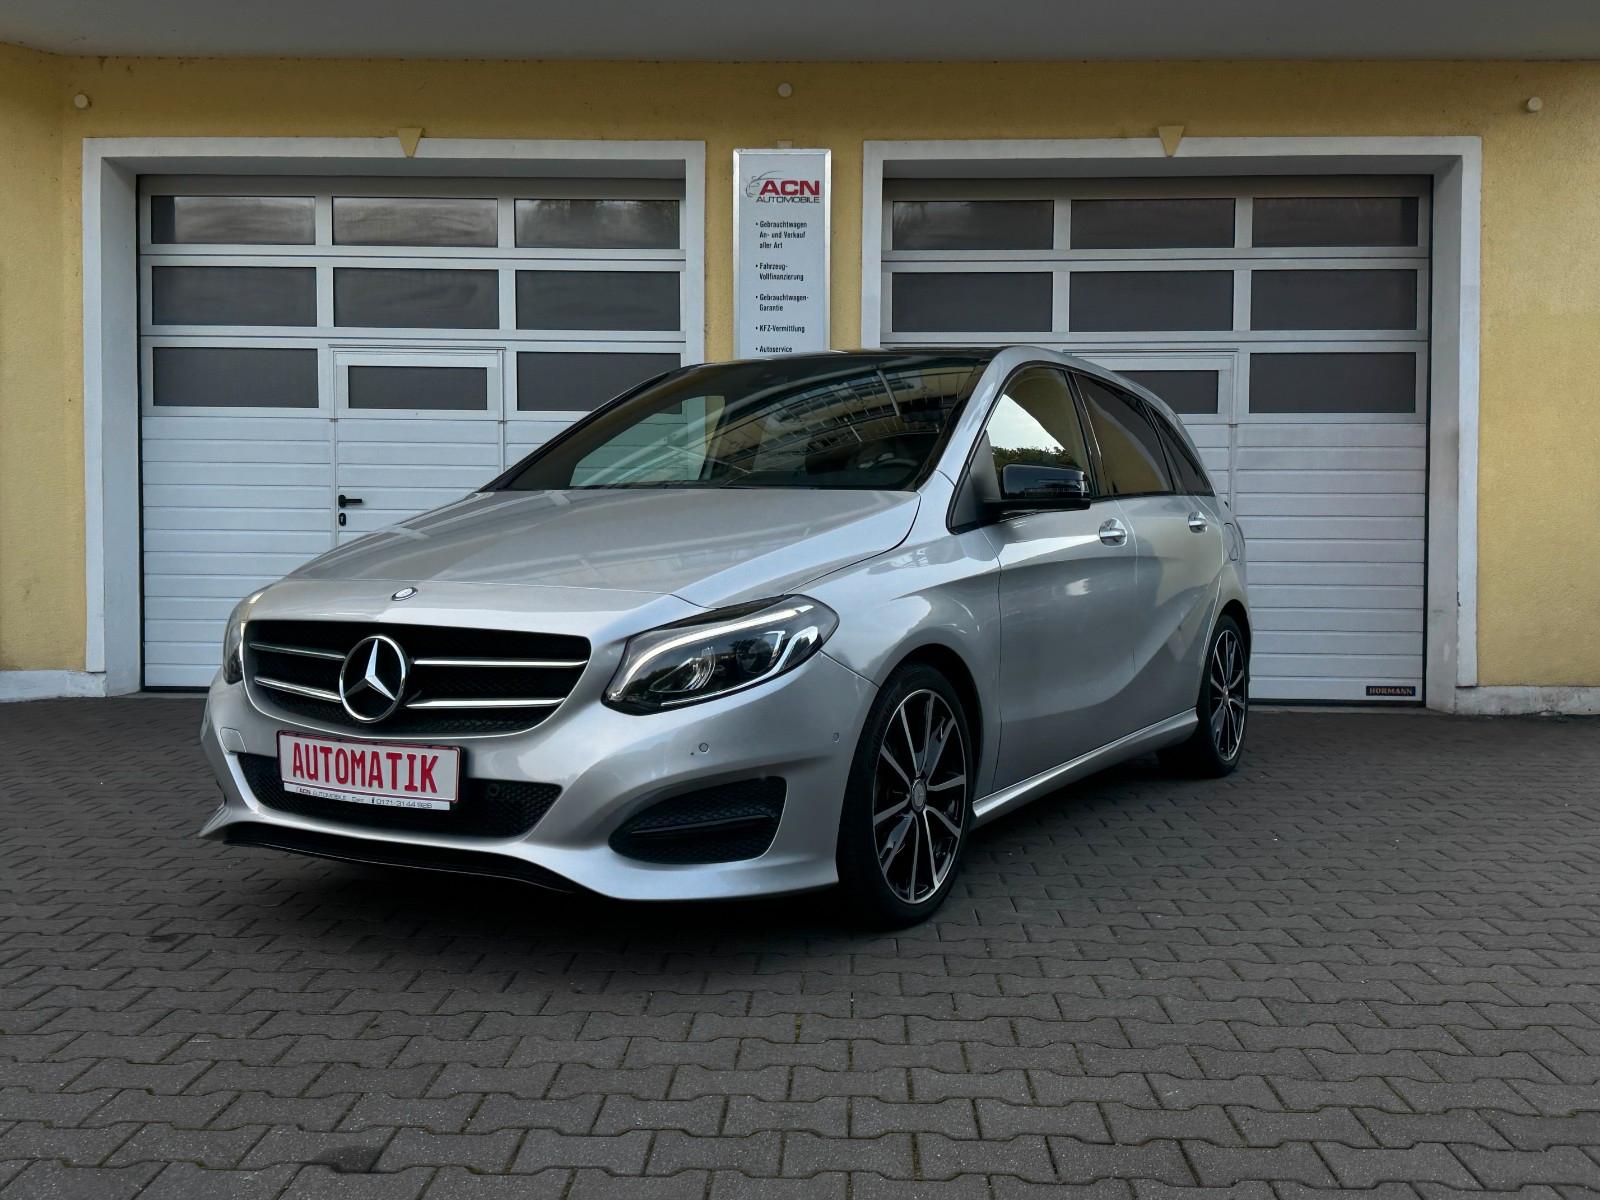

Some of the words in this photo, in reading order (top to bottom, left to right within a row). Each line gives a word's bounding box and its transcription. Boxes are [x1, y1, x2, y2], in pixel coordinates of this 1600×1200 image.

[759, 180, 820, 196] ACN
[756, 196, 821, 204] AUTOMOBILE
[760, 221, 807, 229] Gebrauchtwagen
[783, 231, 806, 239] Verkauf
[760, 263, 788, 271] Fahrzeug-
[760, 273, 804, 281] Vollfinanzierung
[760, 294, 809, 302] Gebrauchtwagen-
[760, 304, 783, 312] Garantie
[760, 325, 805, 333] KFZ-Vermittlung
[760, 345, 793, 353] Autoservice
[292, 742, 439, 793] AUTOMATIK
